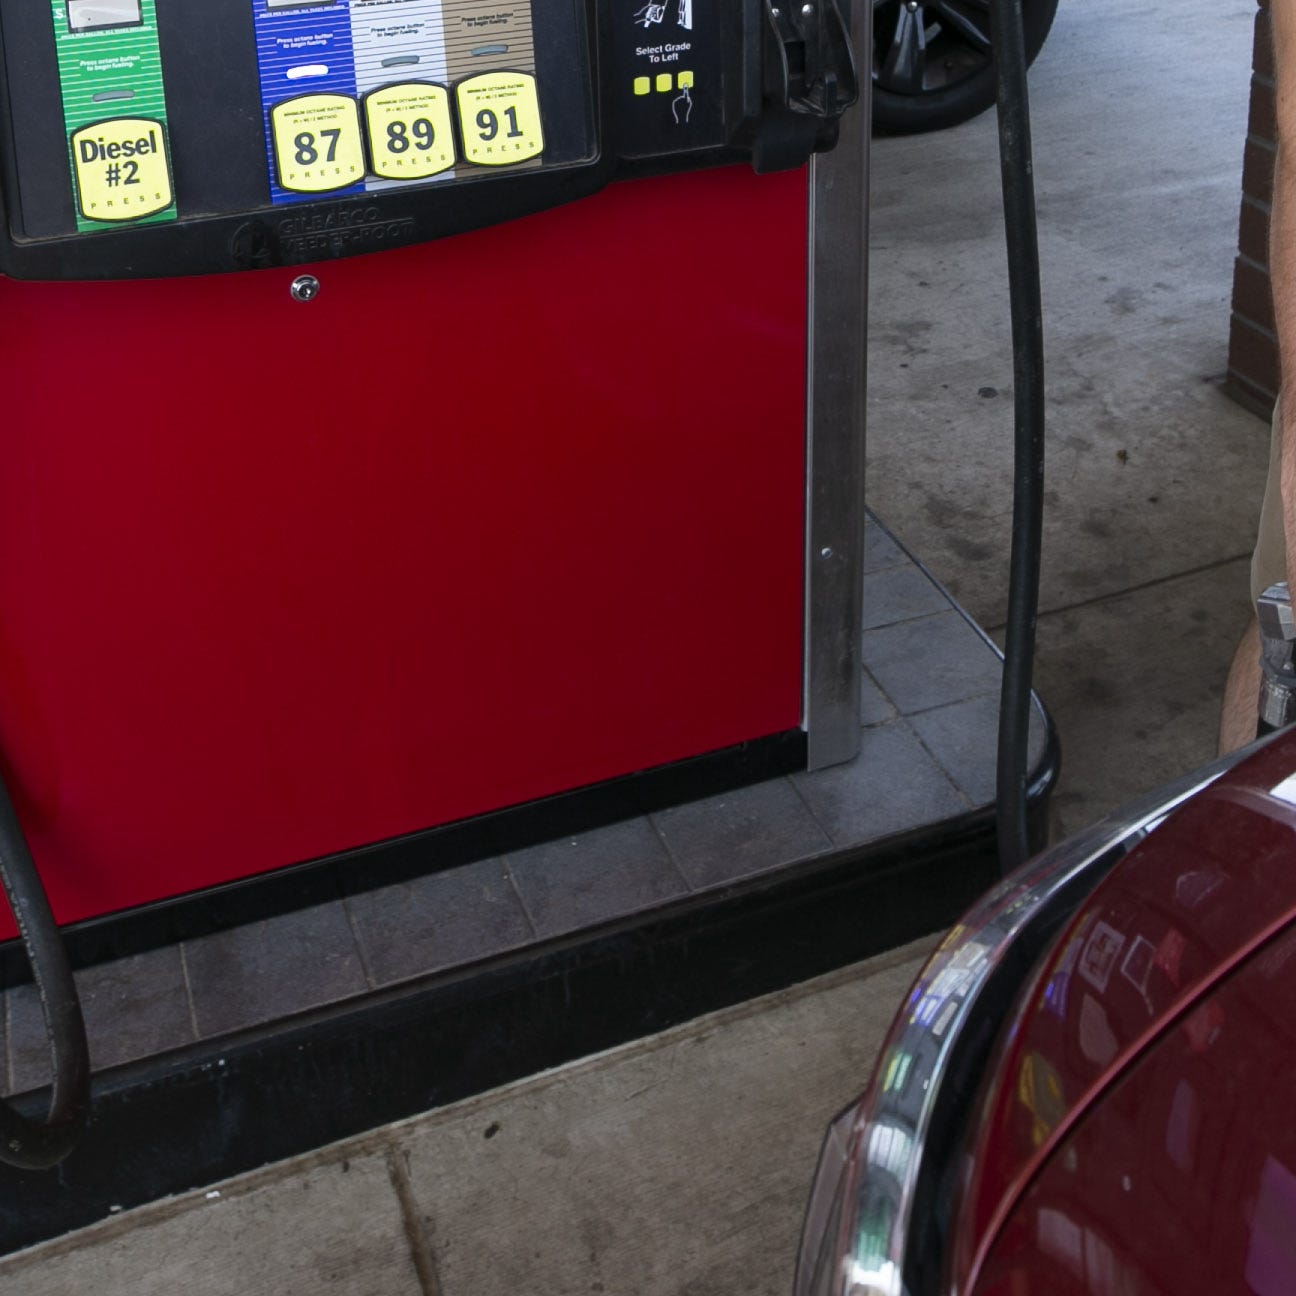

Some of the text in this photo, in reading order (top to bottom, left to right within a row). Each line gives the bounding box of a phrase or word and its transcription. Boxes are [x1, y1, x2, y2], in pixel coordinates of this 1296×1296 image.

[636, 43, 691, 56] Select Grade
[649, 52, 679, 63] To Left
[475, 106, 524, 141] 91
[80, 130, 157, 163] Diesel
[294, 127, 342, 166] 87
[386, 117, 435, 154] 89
[472, 141, 535, 155] PRESS
[382, 154, 446, 168] PRESS
[106, 160, 140, 187] #2
[289, 165, 355, 180] PRESS
[91, 192, 160, 209] PRESS
[278, 206, 382, 234] GILBARCO
